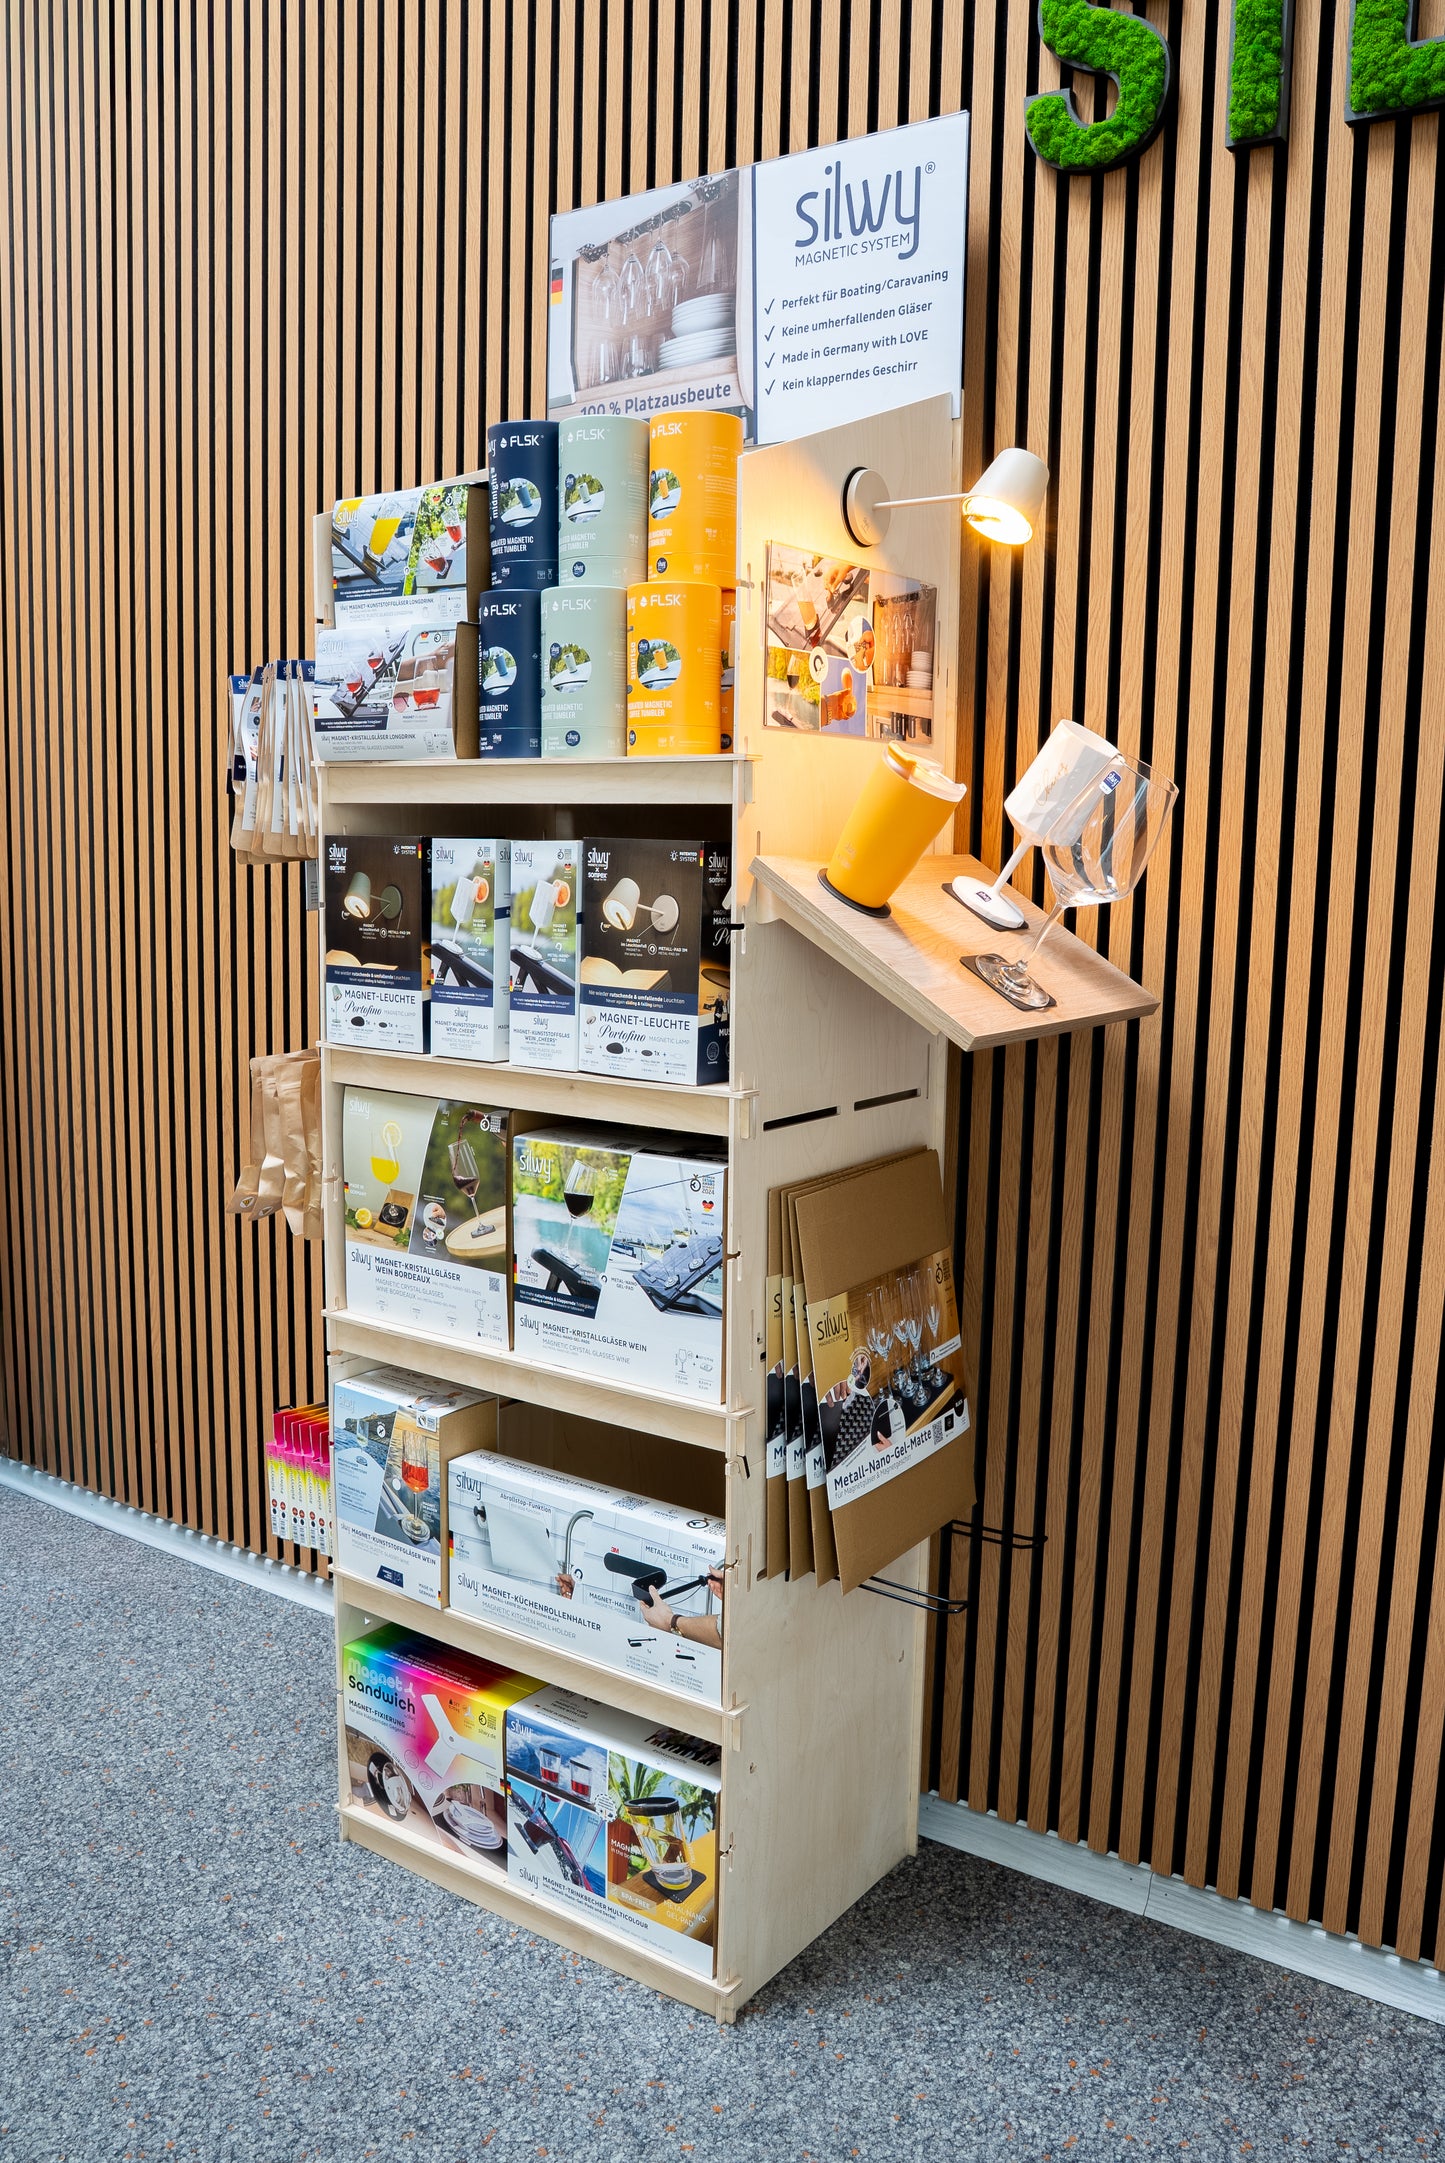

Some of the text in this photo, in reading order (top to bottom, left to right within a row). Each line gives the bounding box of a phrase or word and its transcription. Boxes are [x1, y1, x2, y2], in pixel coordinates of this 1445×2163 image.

[795, 232, 911, 267] MAGNETIC SYSTEM
[781, 268, 950, 310] Perfekt für Boating/Caravaning
[781, 300, 933, 338] Keine umherfallenden Gläser
[781, 329, 929, 364] Made in Germany with LOVE
[781, 359, 919, 391] Kein klapperndes Geschirr
[580, 383, 732, 416] 100 % Platzausbeute
[576, 428, 606, 441] FLSK
[657, 422, 683, 437] FLSK
[510, 435, 540, 447] FLSK
[504, 544, 527, 553] TUMBLER
[507, 536, 534, 544] MAGNETIC
[490, 604, 517, 616] FLSK
[561, 599, 592, 611] FLSK
[650, 594, 681, 606] FLSK
[329, 843, 347, 863] silwy
[436, 848, 454, 864] silwy
[514, 849, 534, 867] silwy
[587, 848, 611, 869] silwy
[708, 852, 729, 874] silwy
[344, 989, 416, 1005] MAGNET-LEUCHTE
[343, 1000, 382, 1016] Portofino
[599, 1012, 690, 1031] MAGNET-LEUCHTE
[598, 1024, 647, 1043] Portofino
[519, 1151, 553, 1184] silwy
[351, 1249, 372, 1271] silwy
[374, 1256, 461, 1282] MAGNET-KRISTALLGLÄSER
[375, 1265, 431, 1285] WEIN BORDEAUX
[375, 1278, 445, 1299] MAGNETIC CRYSTAL GLASSES
[390, 1289, 417, 1299] BORDEAUX
[519, 1315, 540, 1336] silwy
[816, 1310, 849, 1342] silwy
[542, 1322, 648, 1352] MAGNET-KRISTALLGLÄSER WEIN
[542, 1338, 630, 1364] MAGNETIC CRYSTAL GLASSES WINE
[834, 1429, 932, 1491] Metall-Nano-Gel-Matte
[455, 1472, 483, 1501] silwy
[835, 1489, 844, 1499] für
[844, 1474, 876, 1497] Magnetgläser
[880, 1454, 912, 1477] Magnetgeschirr
[500, 1493, 552, 1514] Abrollstop-Funktion
[645, 1545, 689, 1565] METALL-LEISTE
[691, 1542, 717, 1556] silwy.de
[422, 1556, 436, 1565] WEIN
[457, 1573, 480, 1597] silwy
[482, 1584, 601, 1632] MAGNET-KÜCHENROLLENHALTER
[589, 1592, 636, 1613] MAGNET-HALTER
[482, 1601, 577, 1639] MAGNETIC KITCHEN ROLL HOLDER
[348, 1657, 403, 1692] magnet
[348, 1675, 416, 1715] Sandwich
[349, 1699, 406, 1728] MAGNET-FIXIERUNG
[511, 1718, 533, 1737] silwy
[519, 1866, 541, 1890] silwy
[542, 1875, 607, 1911] MAGNET-TRINKBECHER
[607, 1907, 649, 1930] MULTICOLOUR
[621, 1891, 651, 1909] BPA-FREE
[666, 1910, 695, 1928] GEL-PAD
